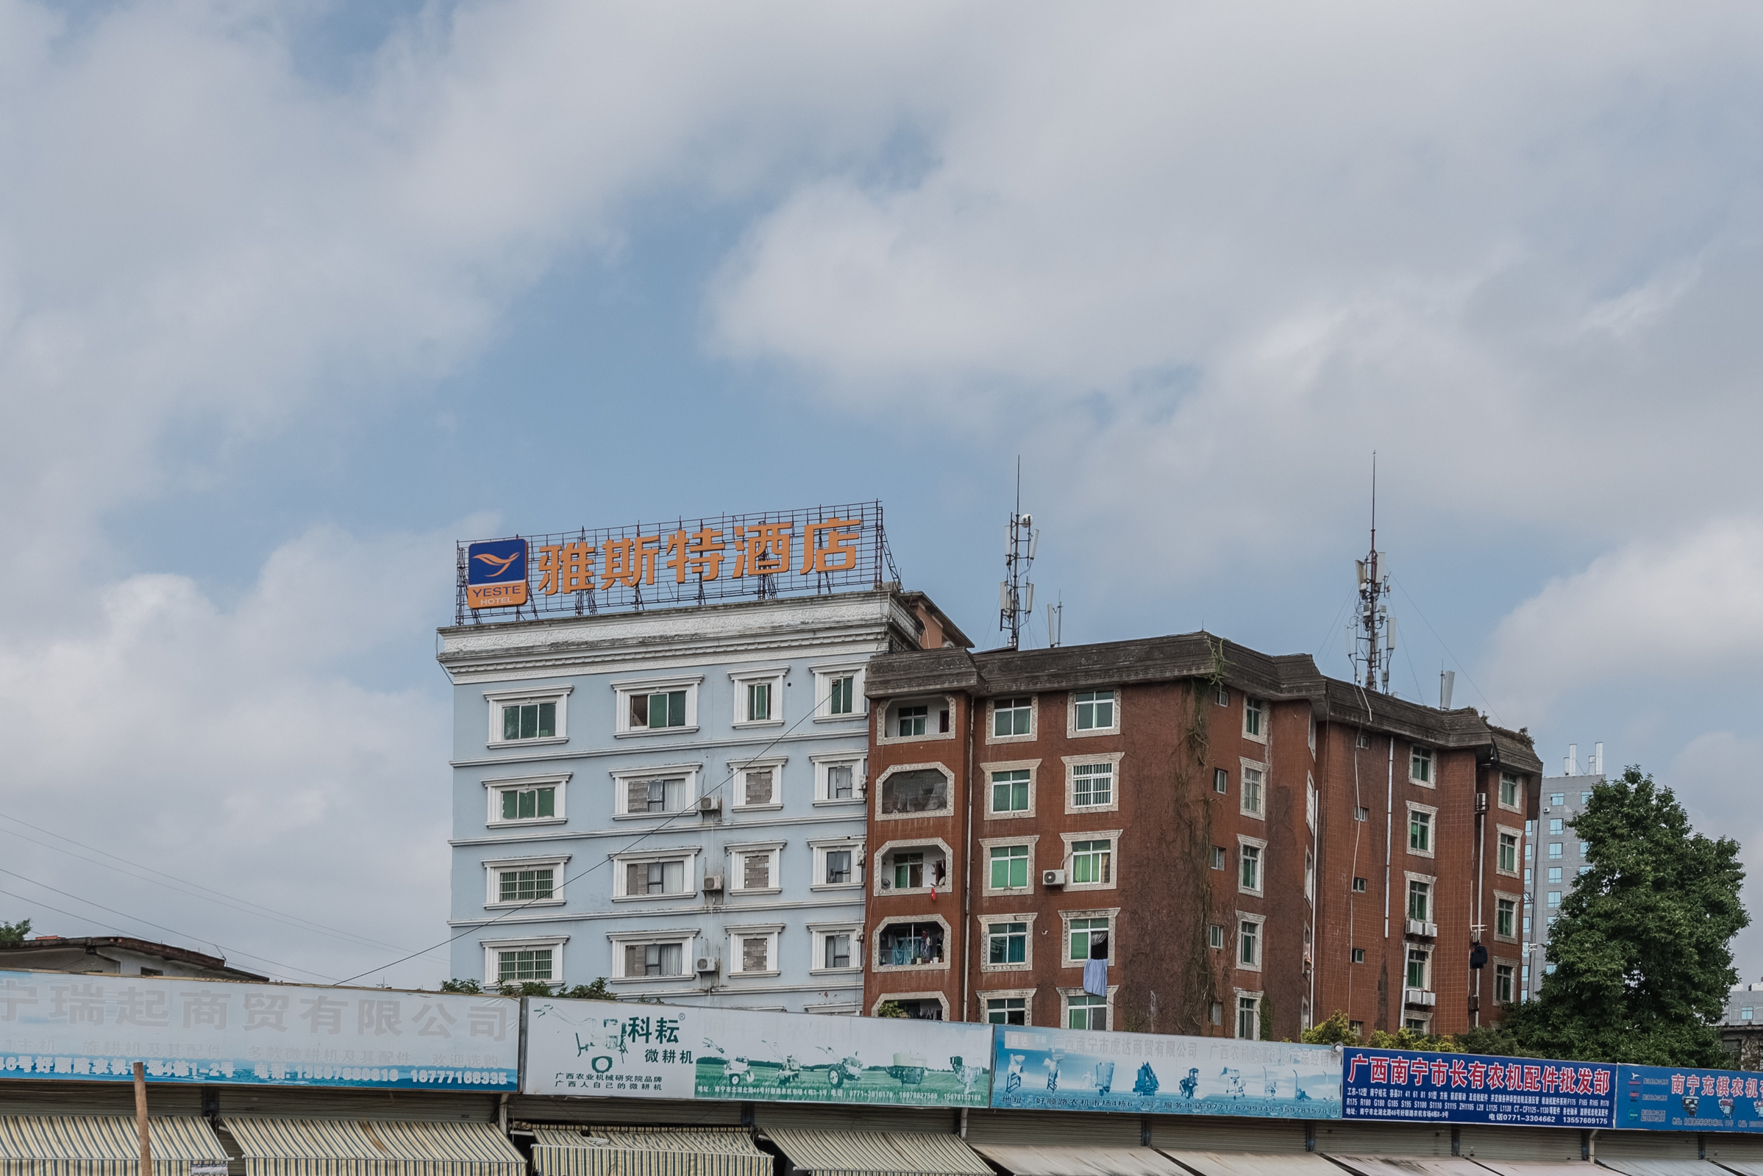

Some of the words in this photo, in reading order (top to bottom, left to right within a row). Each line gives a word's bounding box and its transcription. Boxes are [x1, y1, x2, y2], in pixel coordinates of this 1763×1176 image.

[538, 518, 861, 596] 雅斯特酒店
[472, 585, 522, 599] YESTE
[480, 597, 514, 607] HOTEL
[627, 1016, 681, 1045] 科耘
[1052, 1034, 1198, 1061] 广西南宁市虎达商贸有限公司
[644, 1048, 694, 1065] 微耕机
[555, 1072, 663, 1083] 广西农业机械研究院品牌
[1347, 1053, 1611, 1097] 广西南宁市长有农机配件批发部
[555, 1080, 663, 1091] 广西人自己的微耕机
[1671, 1073, 1763, 1099] 南宁充棋农机
[1563, 1116, 1609, 1125] 13557609175
